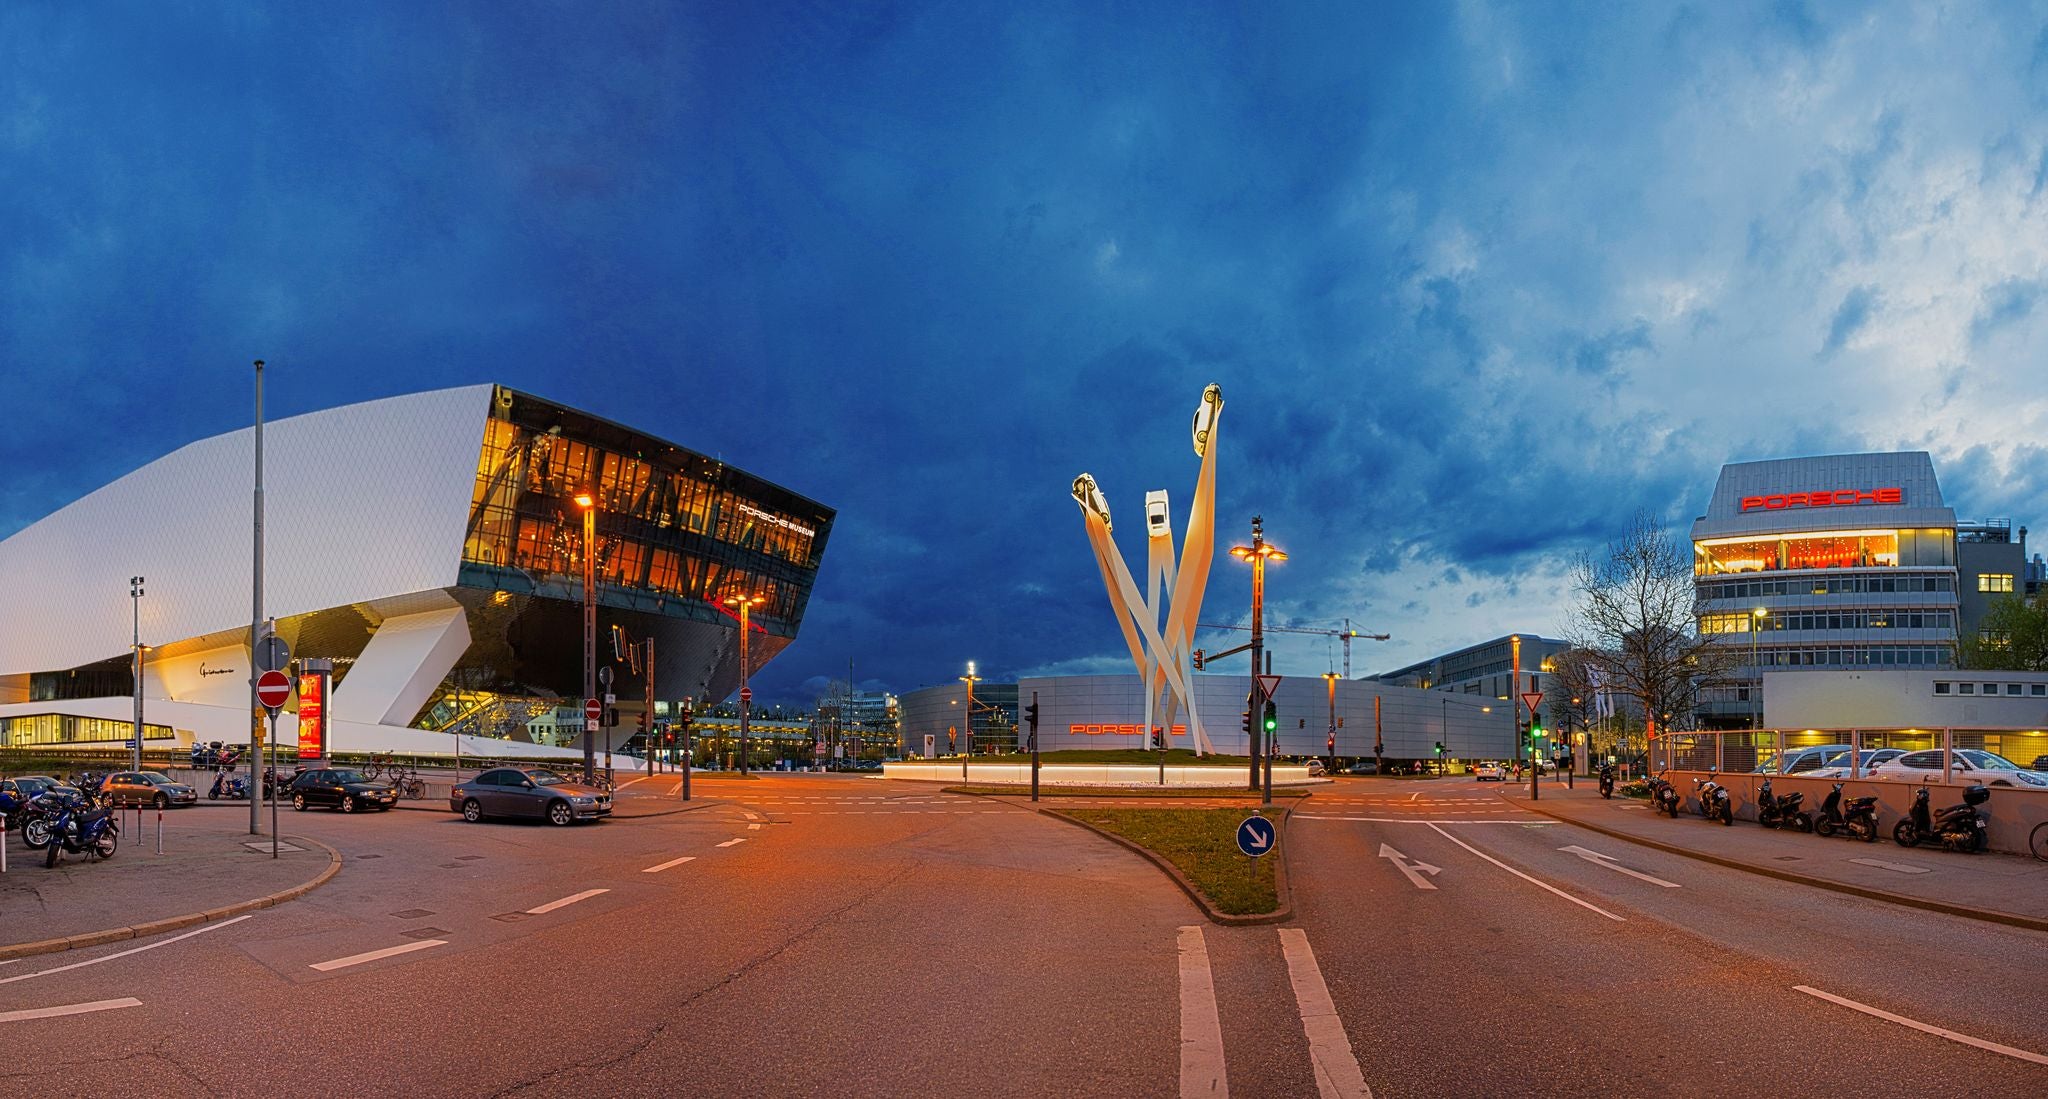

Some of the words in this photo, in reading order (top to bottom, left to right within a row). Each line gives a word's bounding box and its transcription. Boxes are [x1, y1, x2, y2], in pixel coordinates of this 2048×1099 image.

[1742, 488, 1901, 511] PORSCHE
[739, 504, 788, 528] PORSCHE
[788, 522, 815, 538] MUSEUM
